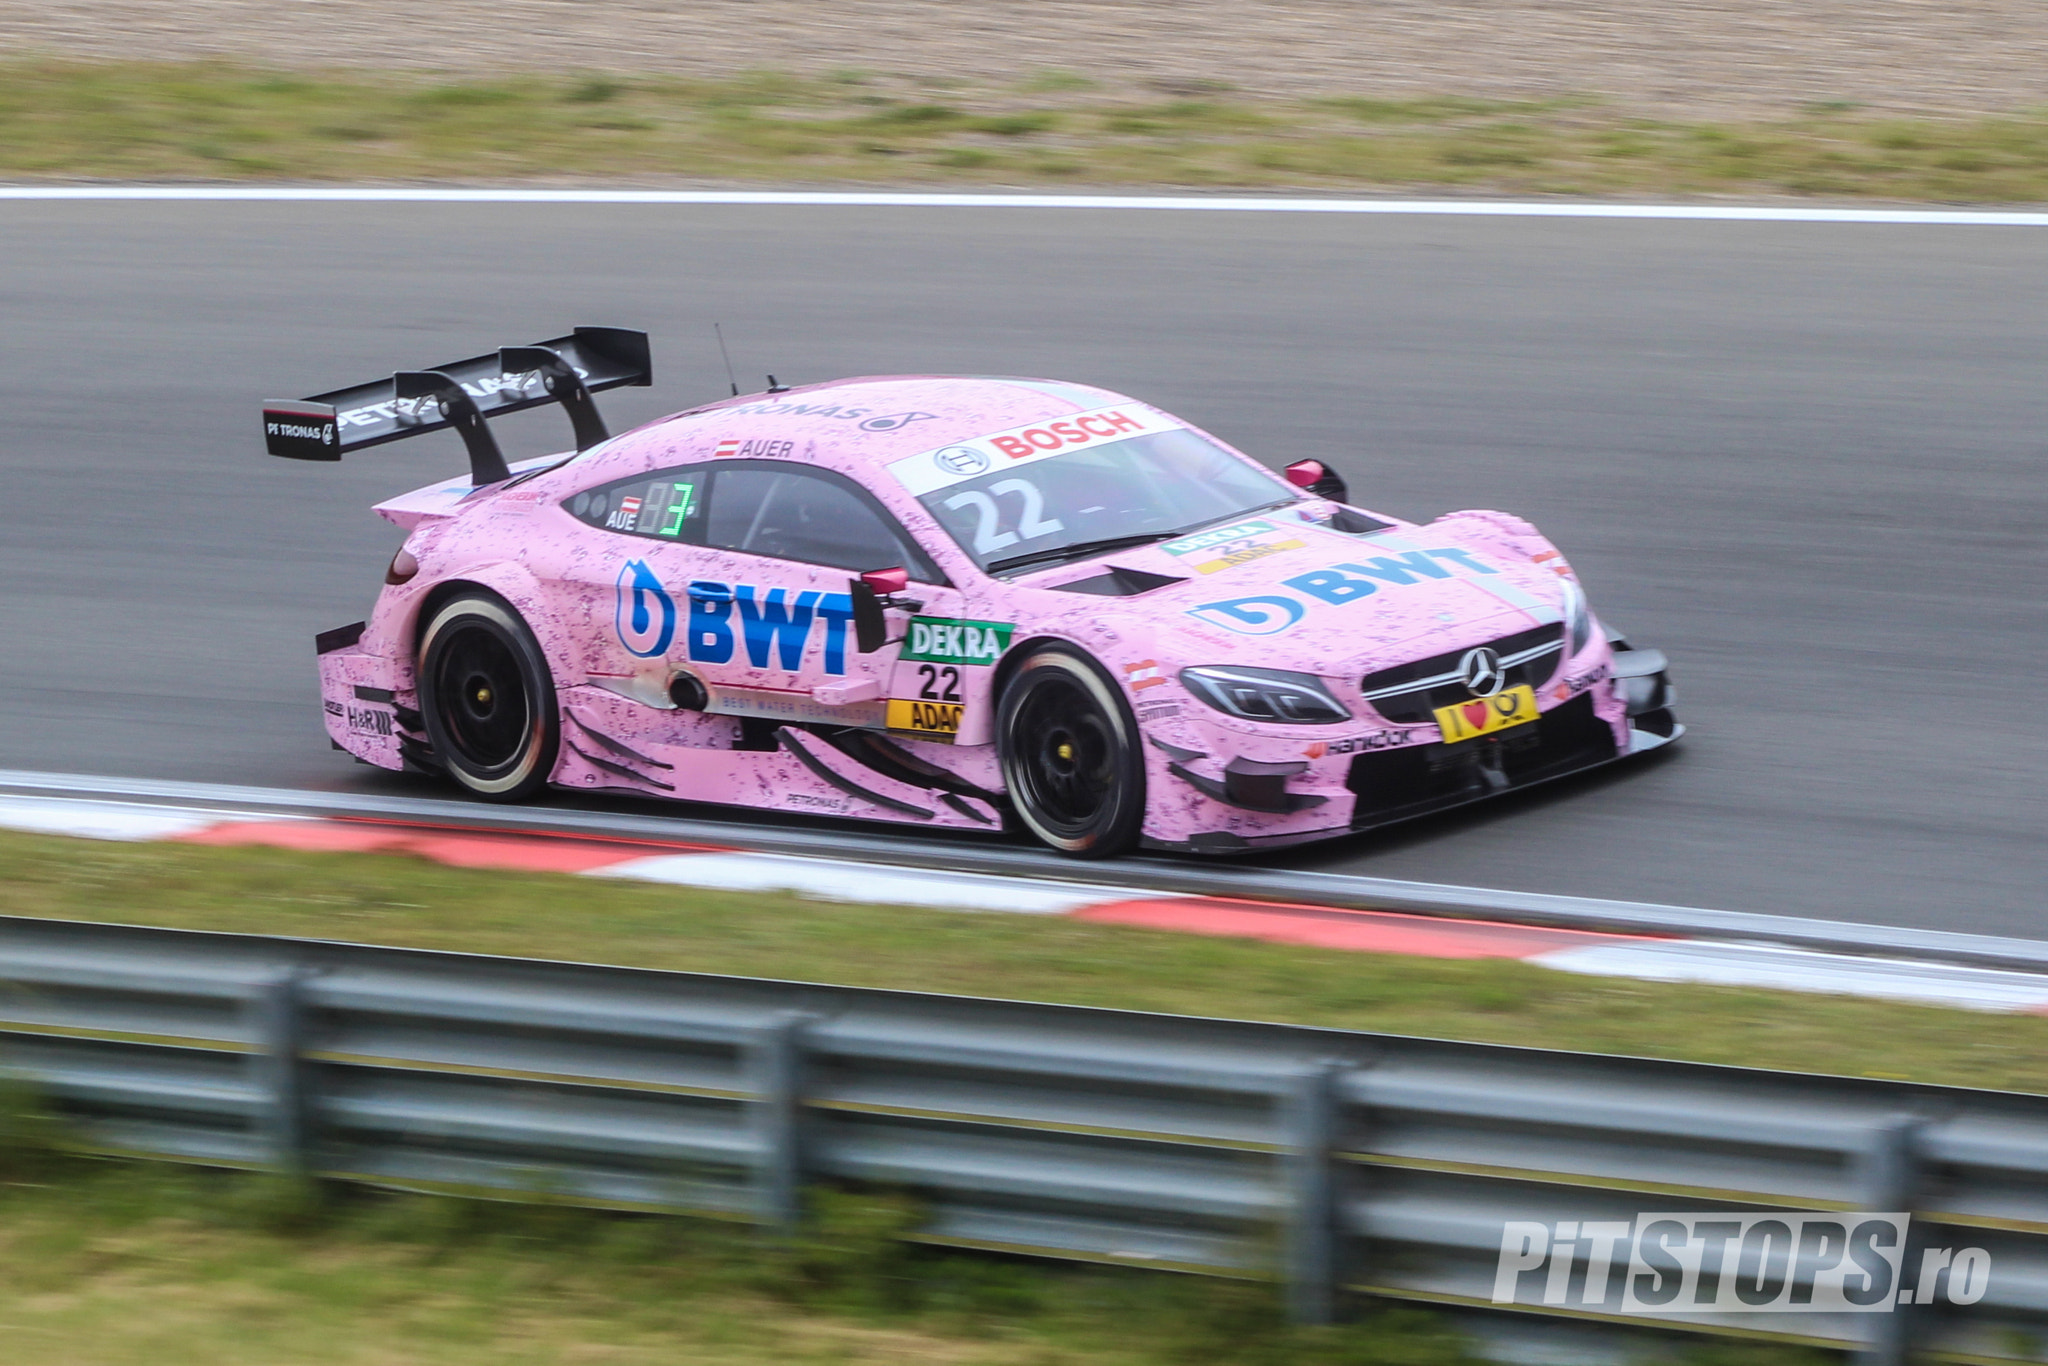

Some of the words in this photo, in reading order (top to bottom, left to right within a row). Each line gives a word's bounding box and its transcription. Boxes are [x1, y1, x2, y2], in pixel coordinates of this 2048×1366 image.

[267, 422, 321, 440] PETRONAS
[989, 411, 1146, 460] BOSCH
[738, 440, 794, 458] AUER
[605, 510, 637, 531] AUE
[943, 479, 1065, 555] 22
[1164, 524, 1274, 552] DEKRA
[1207, 540, 1268, 556] 22
[1280, 548, 1502, 607] BWT
[687, 580, 854, 675] BWT
[911, 622, 1002, 659] DEKRA
[918, 664, 961, 701] 22
[347, 706, 375, 730] H&R
